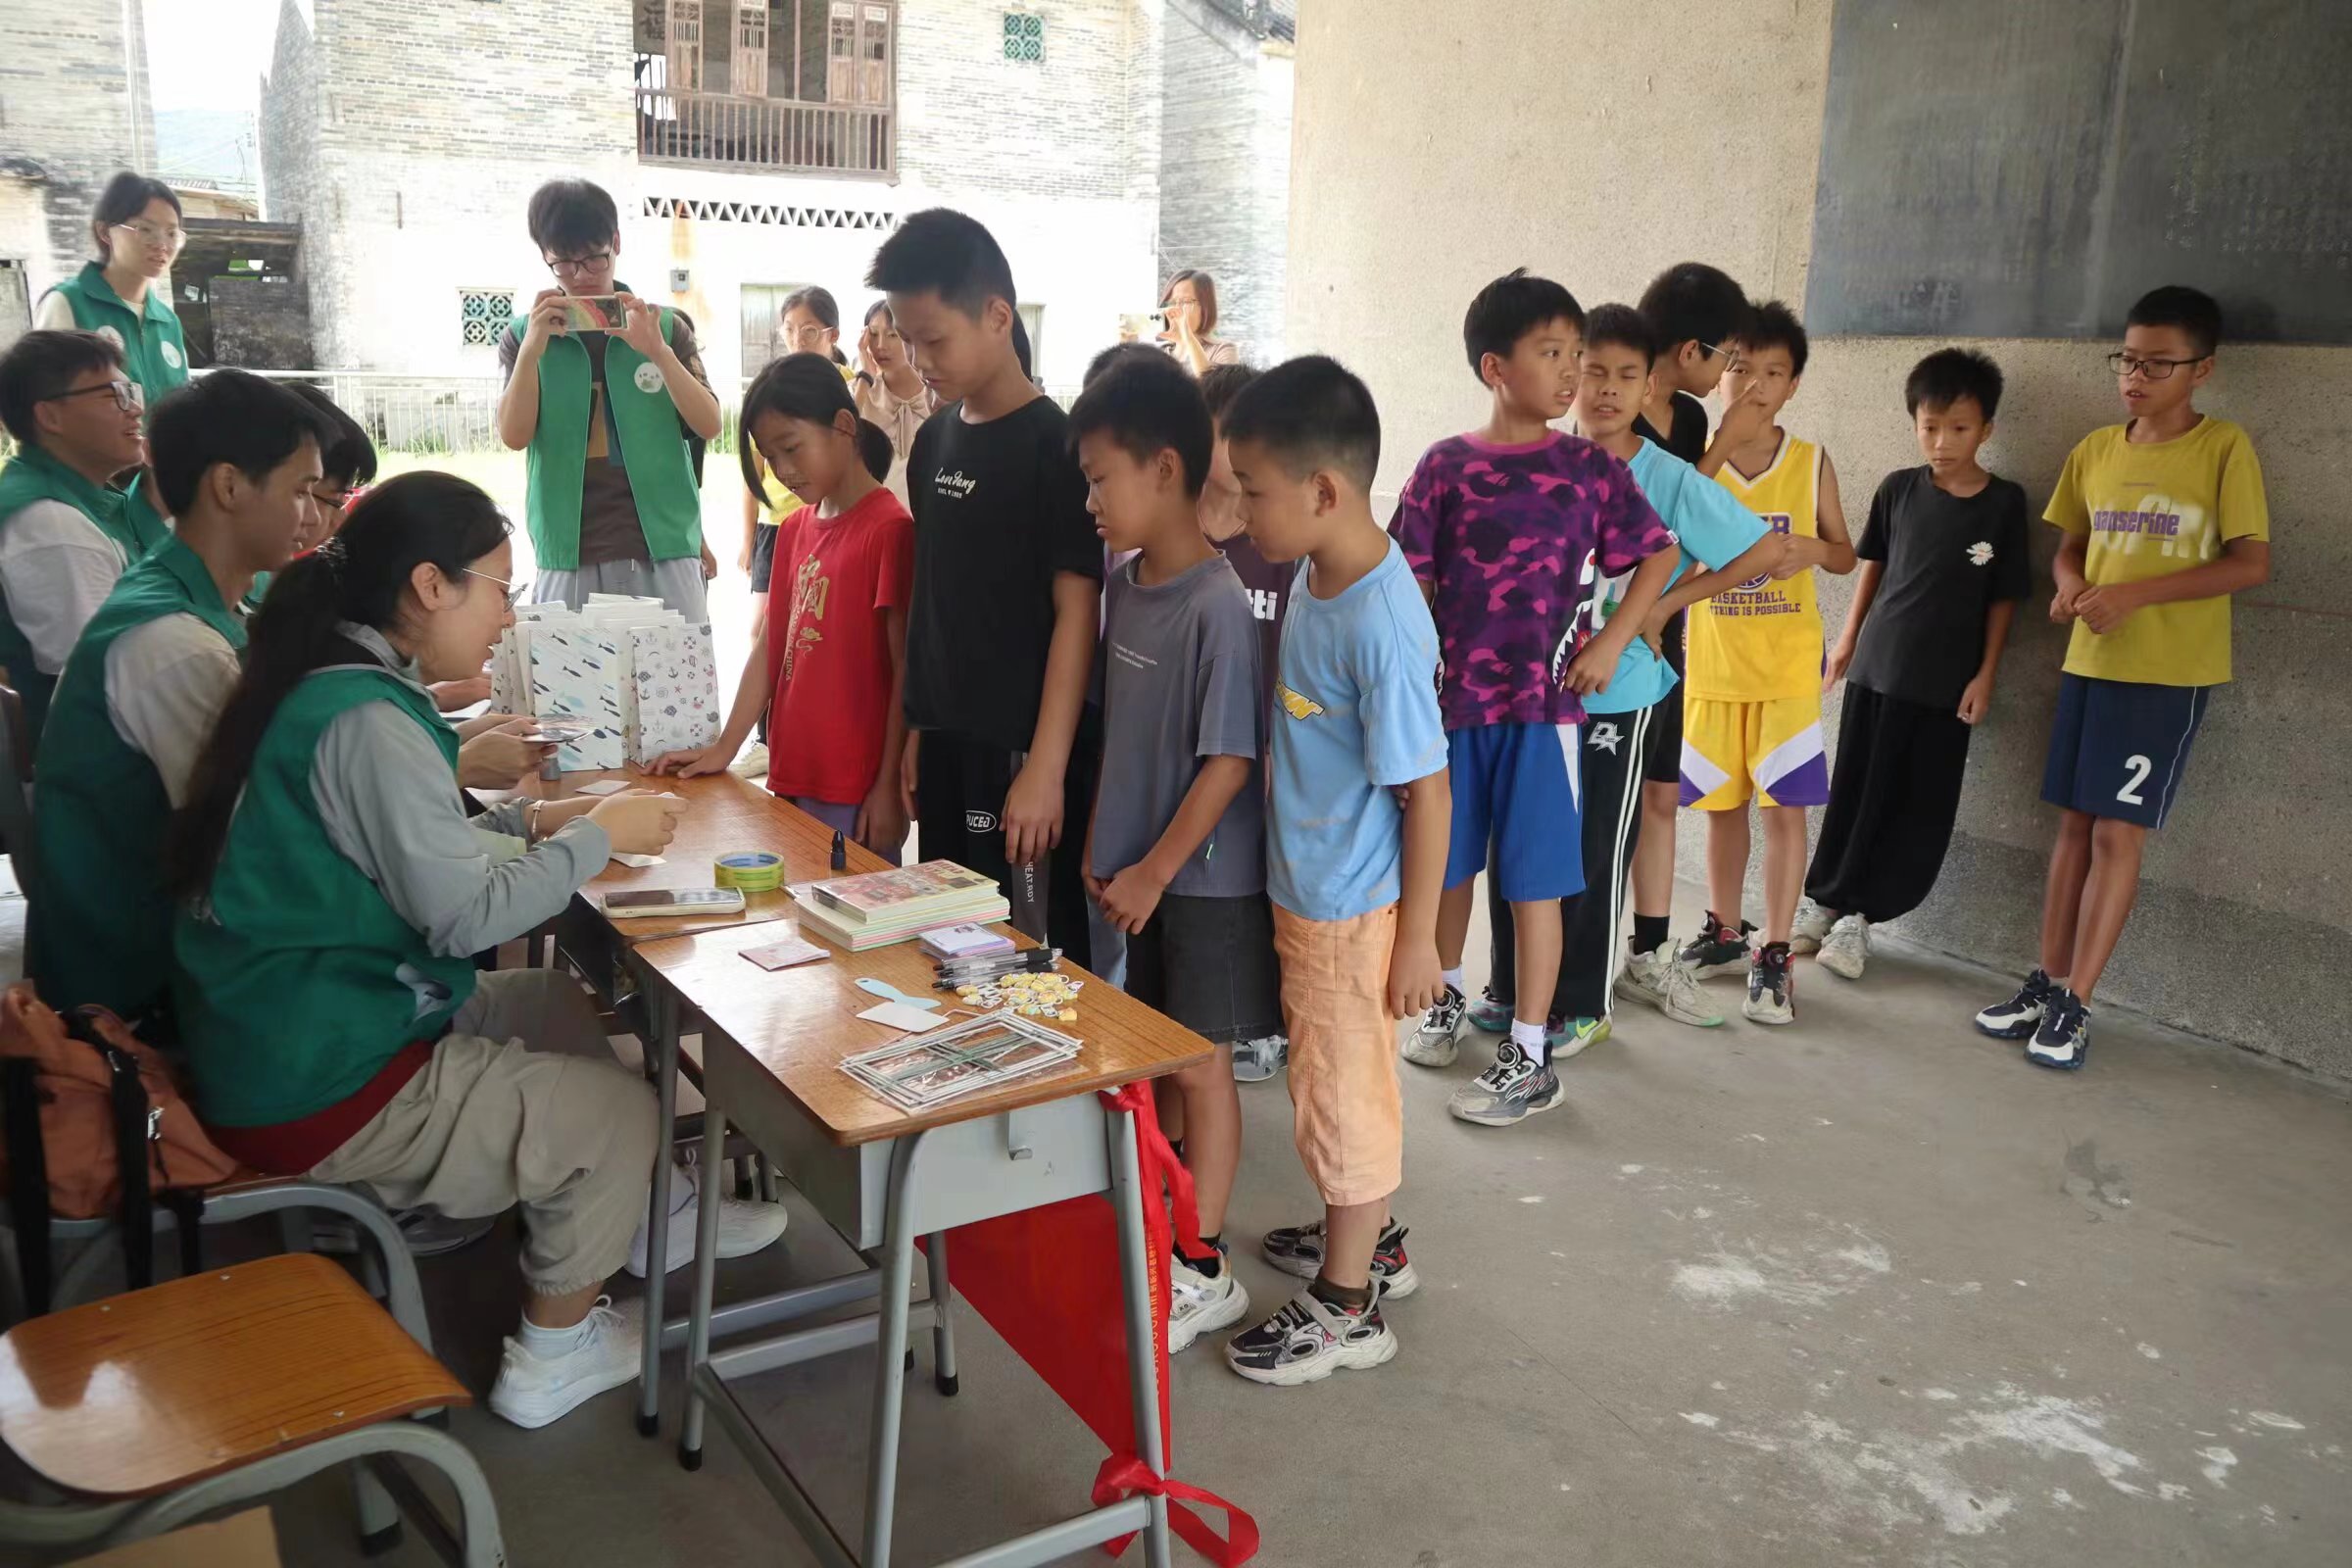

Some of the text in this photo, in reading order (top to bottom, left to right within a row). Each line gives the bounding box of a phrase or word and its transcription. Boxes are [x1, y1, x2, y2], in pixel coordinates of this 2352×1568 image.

[1742, 606, 1752, 616] IS
[1754, 603, 1801, 616] POSSIBLE
[785, 649, 794, 681] CHINA
[2116, 754, 2152, 806] 2
